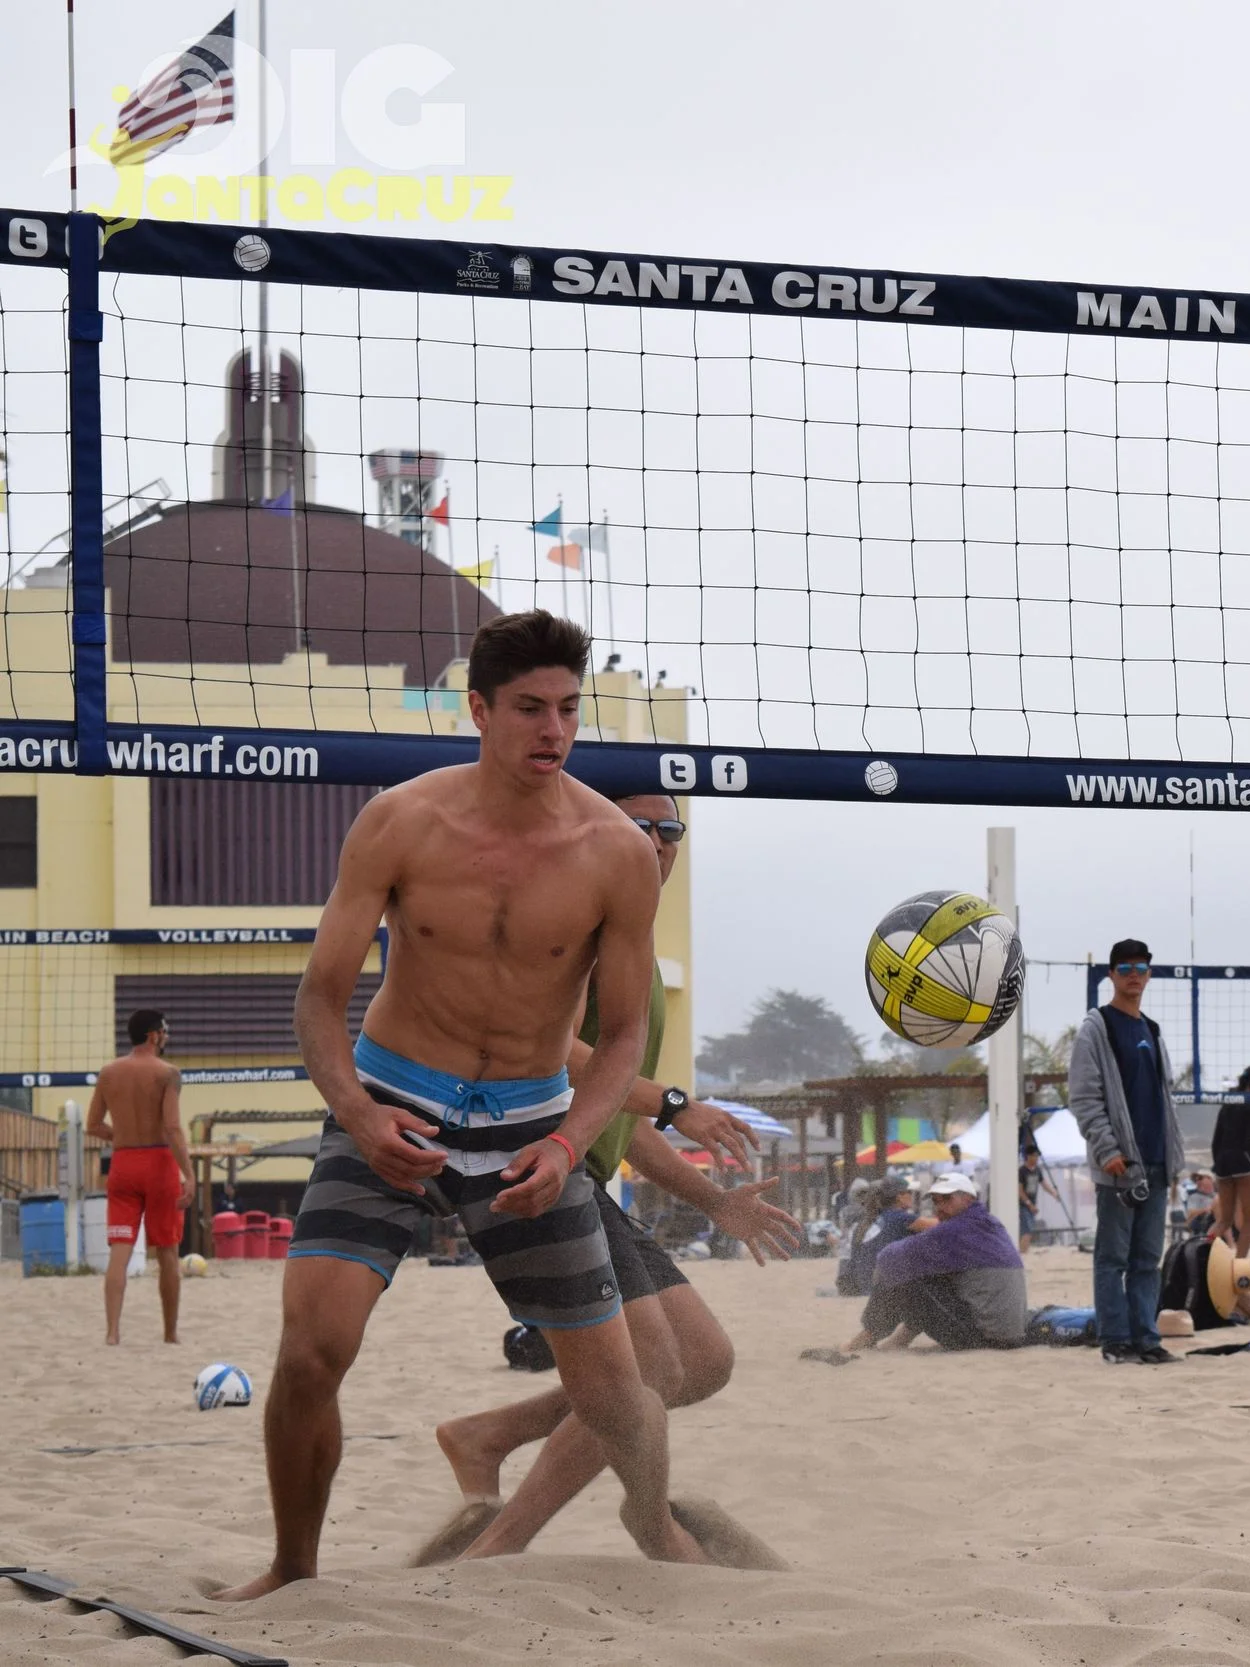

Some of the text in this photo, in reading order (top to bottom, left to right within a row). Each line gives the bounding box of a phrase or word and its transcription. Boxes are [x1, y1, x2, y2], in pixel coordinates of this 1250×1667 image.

[552, 256, 936, 316] SANTA CRUZ
[1076, 292, 1236, 334] MAIN
[953, 900, 978, 915] avp
[36, 931, 110, 943] BEACH
[158, 930, 293, 942] VOLLEYBALL
[904, 975, 923, 1004] avp
